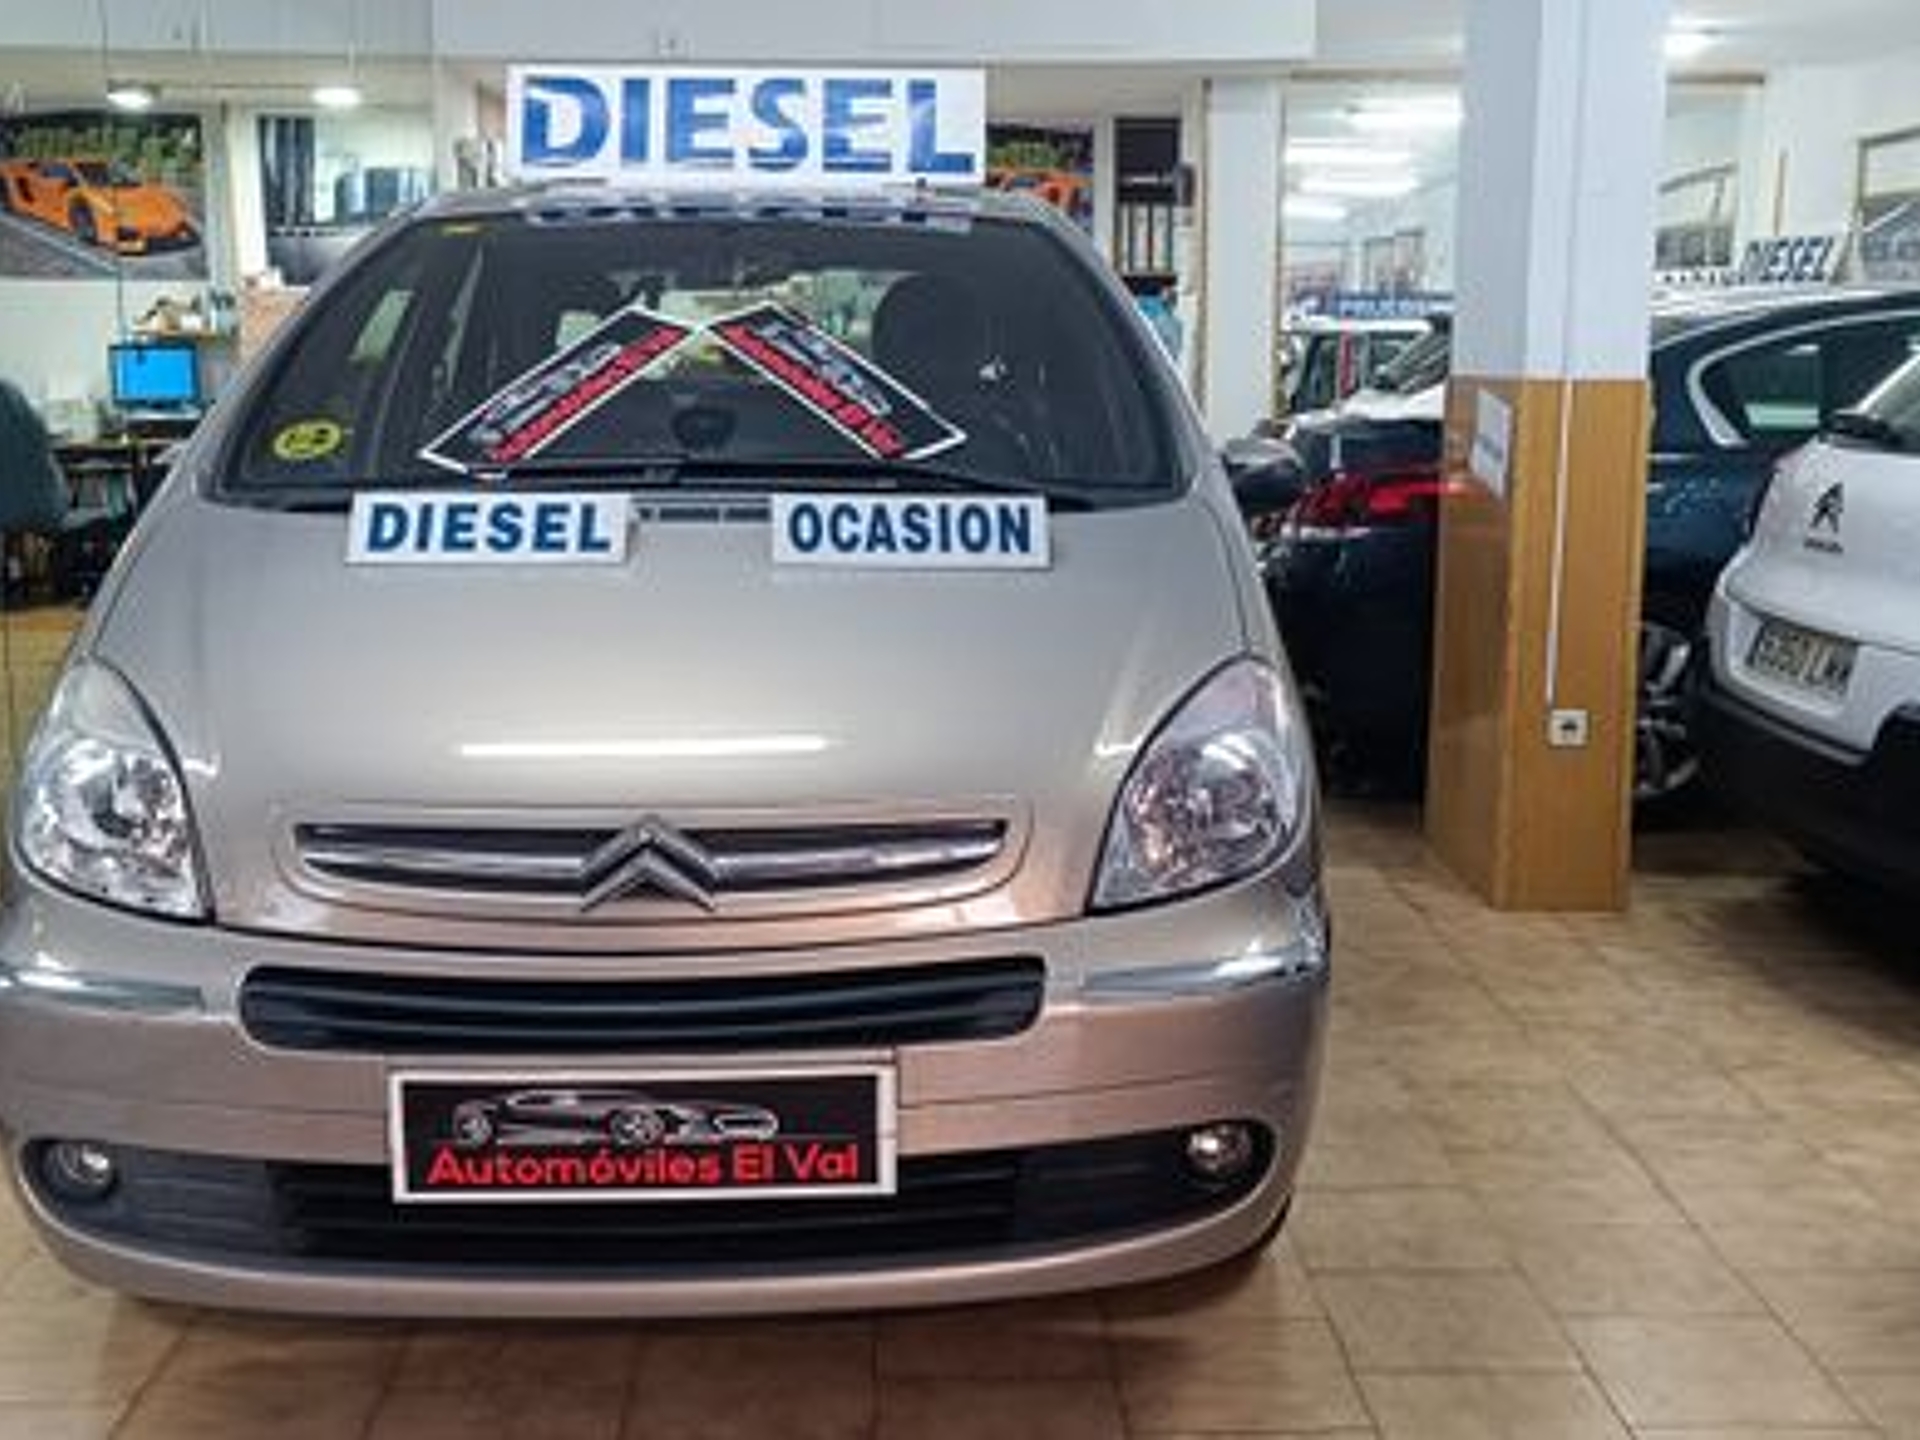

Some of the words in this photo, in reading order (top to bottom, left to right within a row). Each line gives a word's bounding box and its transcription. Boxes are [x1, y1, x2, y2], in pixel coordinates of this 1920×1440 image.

[521, 76, 976, 173] DIESEL
[368, 502, 612, 552] DIESEL
[788, 502, 1031, 554] OCASION
[427, 1144, 720, 1185] Automóviles
[733, 1144, 775, 1180] El
[784, 1142, 859, 1180] Val
